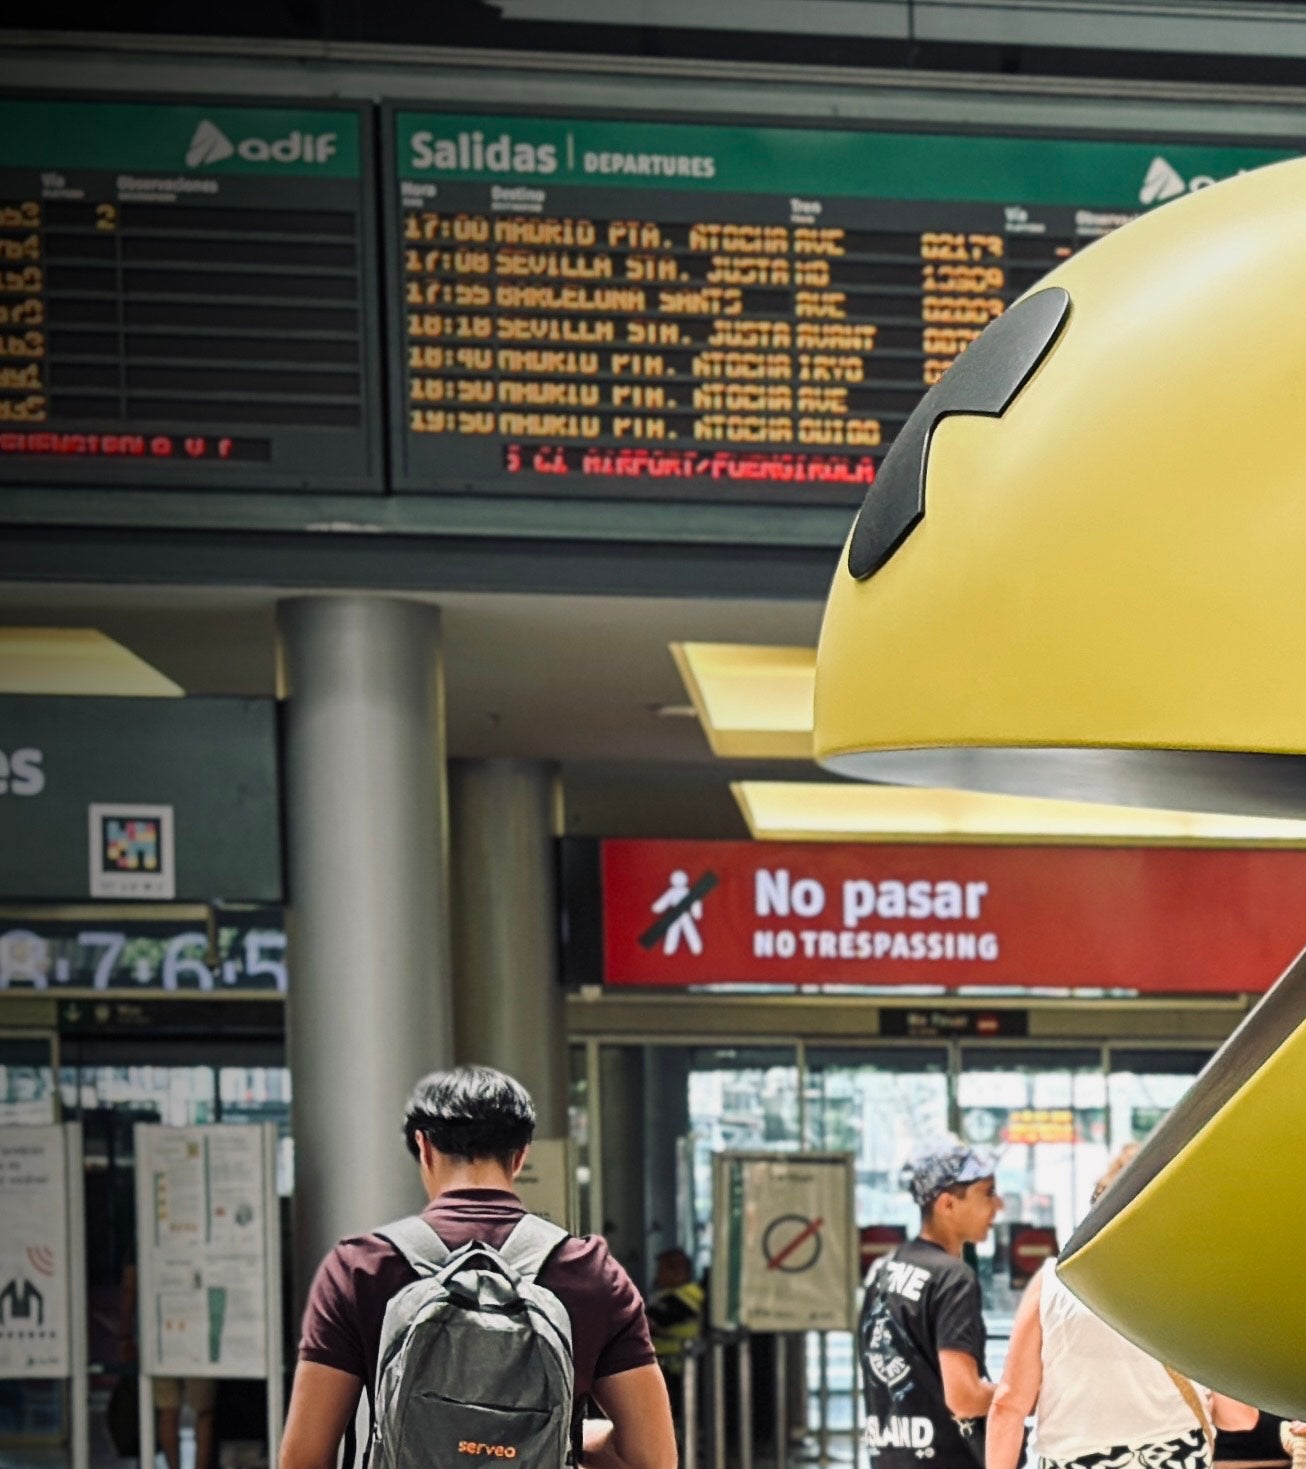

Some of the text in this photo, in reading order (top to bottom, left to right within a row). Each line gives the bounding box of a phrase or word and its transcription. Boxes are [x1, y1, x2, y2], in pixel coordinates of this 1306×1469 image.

[238, 131, 336, 163] adif
[410, 131, 716, 178] Salidas DEPARTURES
[754, 867, 988, 928] No pasar
[754, 930, 999, 962] NO TRESPASSING
[457, 1440, 517, 1459] serveo
